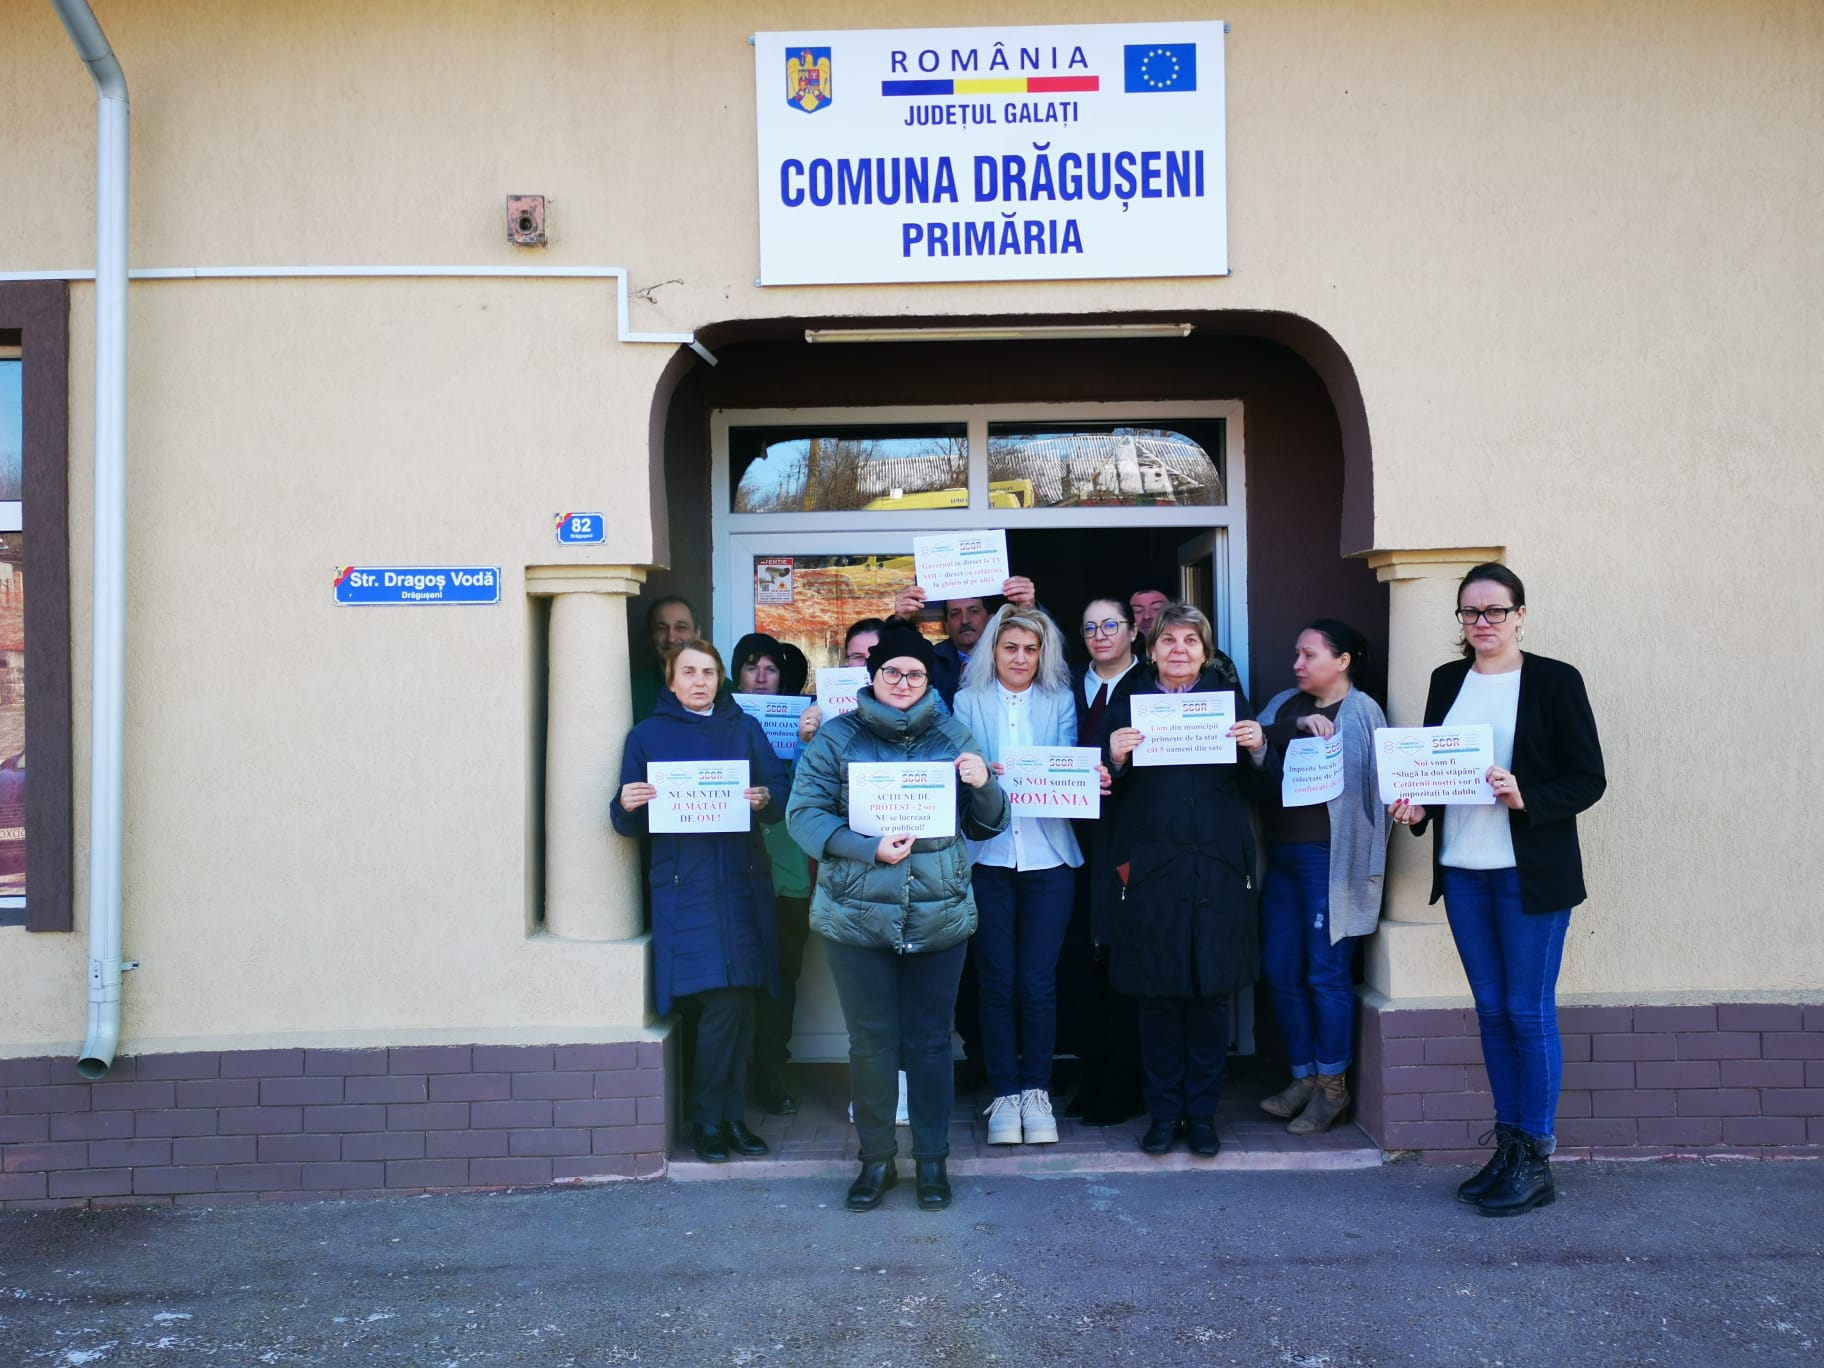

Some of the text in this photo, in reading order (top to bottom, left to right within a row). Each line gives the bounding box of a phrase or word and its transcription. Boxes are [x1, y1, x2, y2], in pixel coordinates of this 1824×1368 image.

[890, 41, 1090, 74] ROMÂNIA
[904, 101, 1079, 130] JUDEȚUL GALAȚI
[780, 141, 1205, 213] COMUNA DRĂGUȘENI
[902, 211, 1084, 258] PRIMĂRIA
[571, 518, 592, 533] 82
[959, 541, 982, 550] SCOR
[350, 571, 494, 590] Str. Dragoș Vodă
[401, 590, 443, 600] Drăgușeni
[828, 695, 858, 705] CONS
[766, 704, 788, 713] SCOR
[1182, 703, 1207, 712] SCOR
[1432, 737, 1460, 748] SCOR
[1049, 758, 1074, 767] SCOR
[1414, 759, 1428, 767] Noi
[902, 773, 927, 783] SCOR
[1026, 777, 1047, 786] NOI
[1050, 778, 1086, 787] suntem
[1474, 777, 1480, 785] fi
[669, 789, 731, 799] NU SUNTEM
[918, 793, 930, 801] DE
[1452, 788, 1476, 796] dublu
[1009, 790, 1088, 806] ROMÂNIA
[870, 803, 910, 812] PROTEST
[680, 814, 695, 823] DE
[891, 824, 925, 833] publicul!
